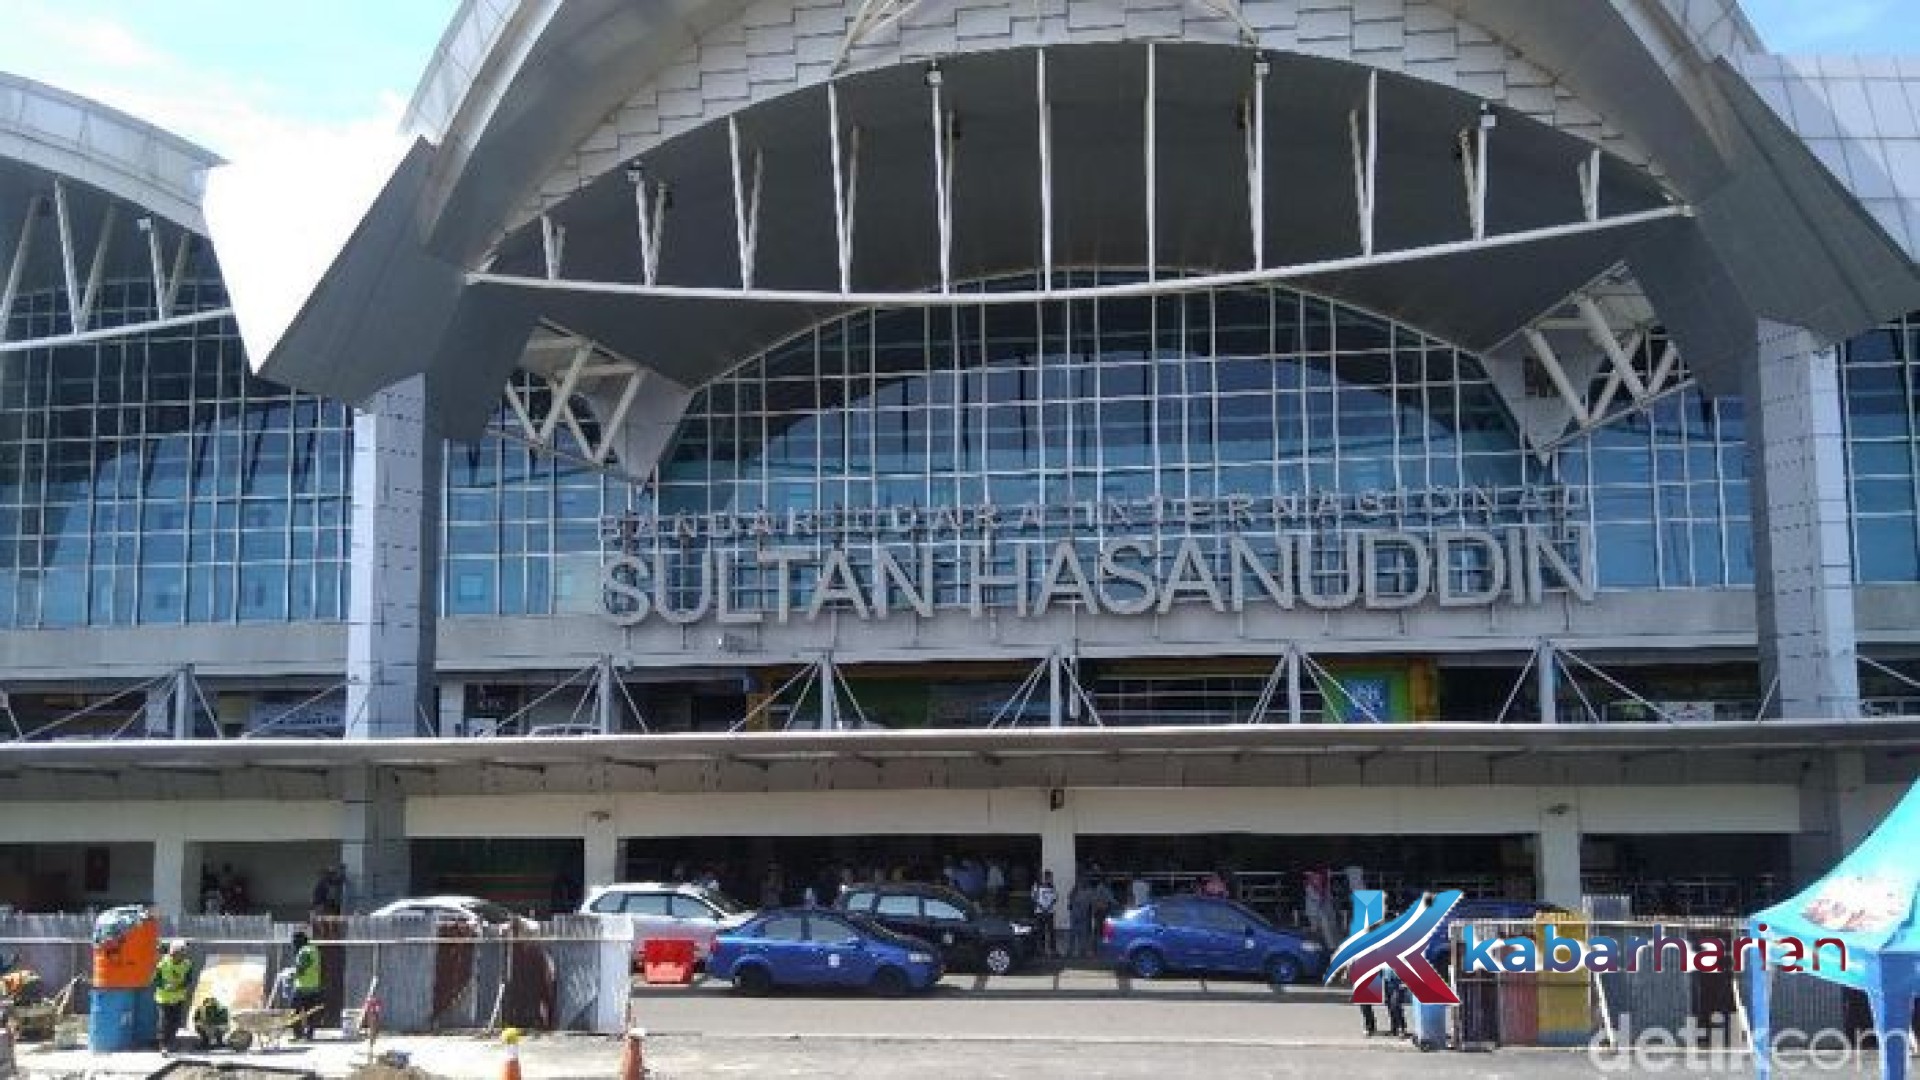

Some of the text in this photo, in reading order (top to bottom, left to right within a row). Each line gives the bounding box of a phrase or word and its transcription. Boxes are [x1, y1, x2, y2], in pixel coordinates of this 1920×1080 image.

[598, 509, 815, 541] BANDAR
[1084, 482, 1584, 528] INTERNASIONAL
[602, 526, 1595, 626] SULTAN HASANUDDIN
